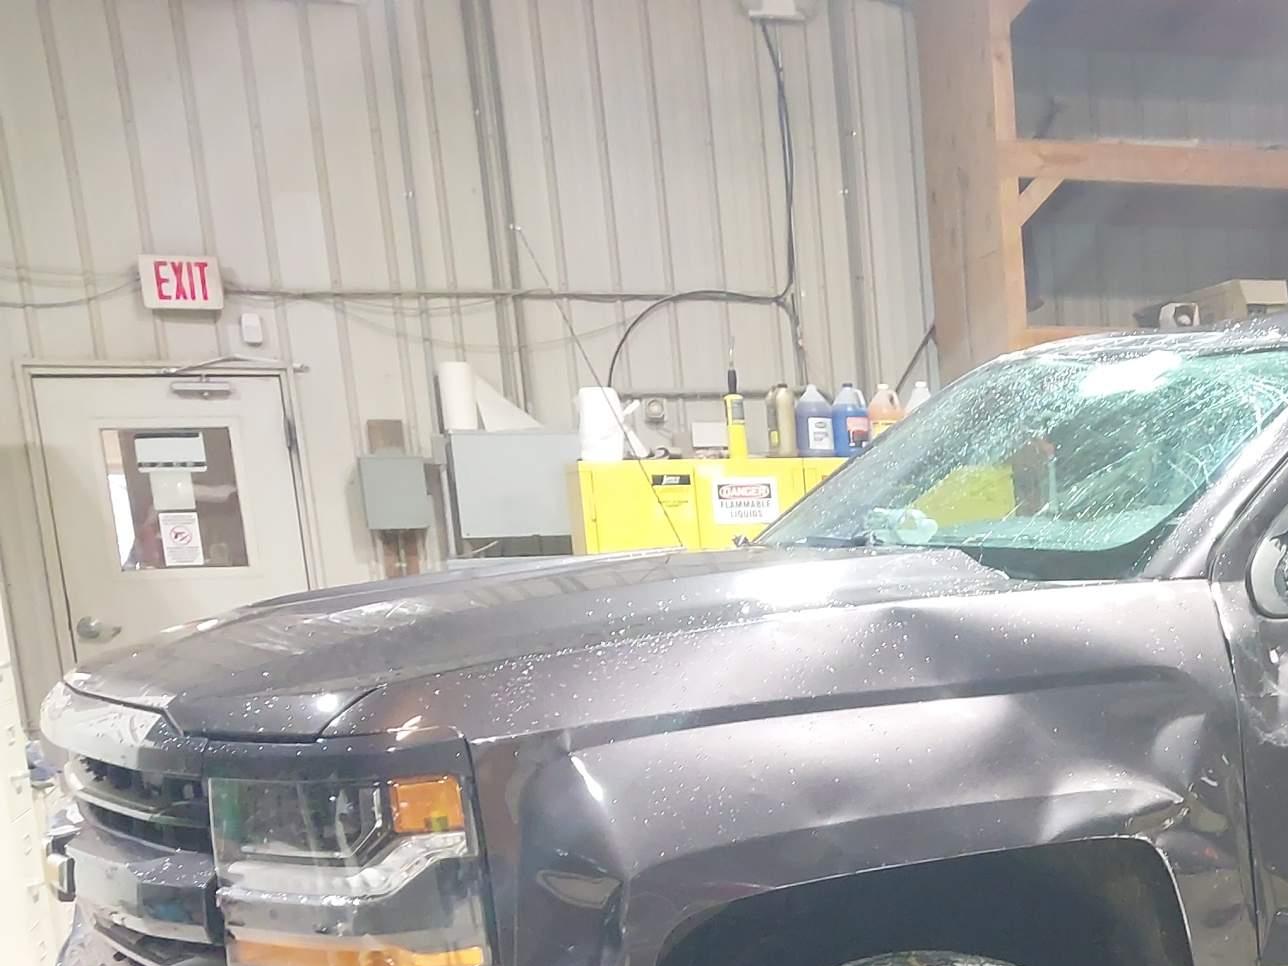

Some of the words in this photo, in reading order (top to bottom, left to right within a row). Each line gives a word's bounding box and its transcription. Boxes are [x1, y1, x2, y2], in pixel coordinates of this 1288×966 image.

[153, 261, 209, 301] EXIT
[721, 485, 769, 498] DANGER
[720, 500, 771, 509] FLAMMABLE
[730, 510, 764, 519] LIQUIDS
